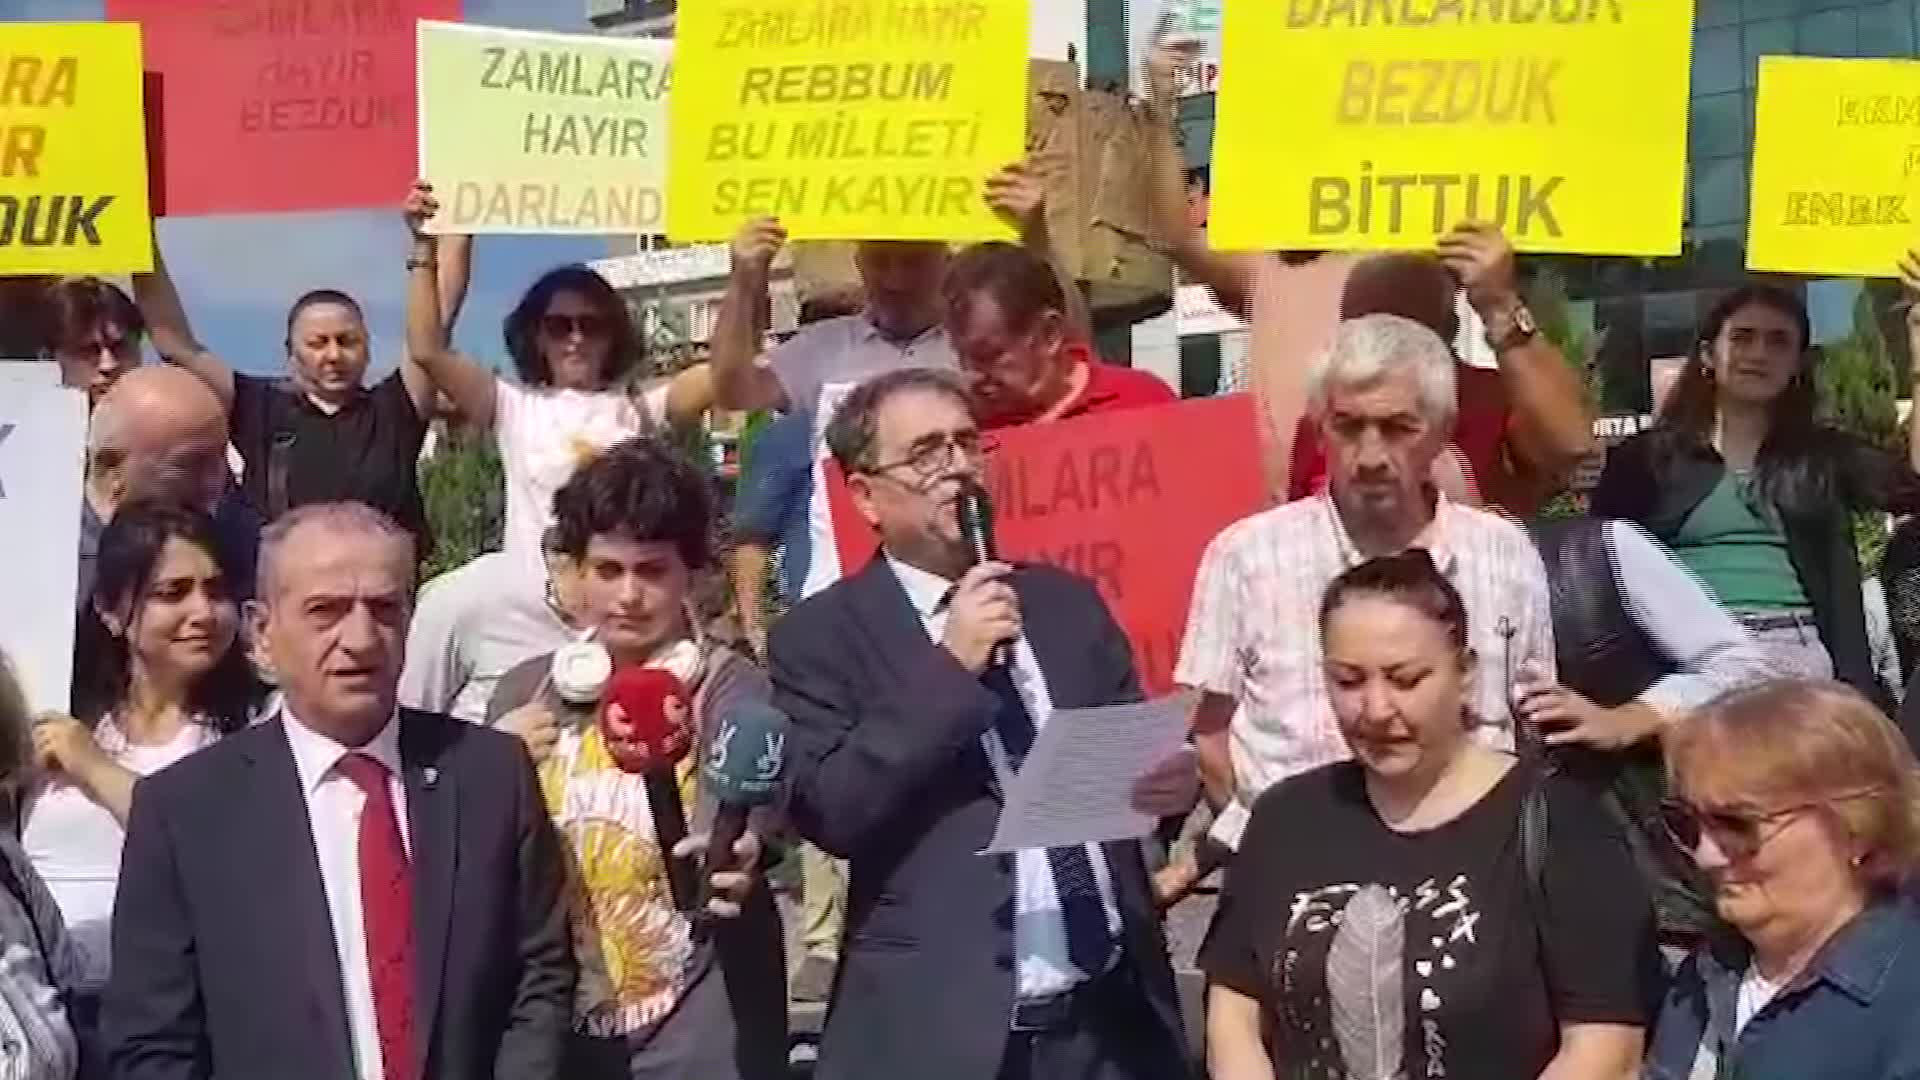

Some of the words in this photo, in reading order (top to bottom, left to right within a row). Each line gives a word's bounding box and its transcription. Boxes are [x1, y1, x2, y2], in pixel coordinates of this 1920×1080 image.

[739, 61, 954, 106] REBBUM
[1335, 57, 1565, 126] BEZDUK
[523, 112, 648, 158] HAYIR
[704, 122, 776, 163] BU
[712, 177, 808, 216] SEN
[821, 175, 975, 217] KAYIR
[1308, 160, 1566, 238] BİTTUK
